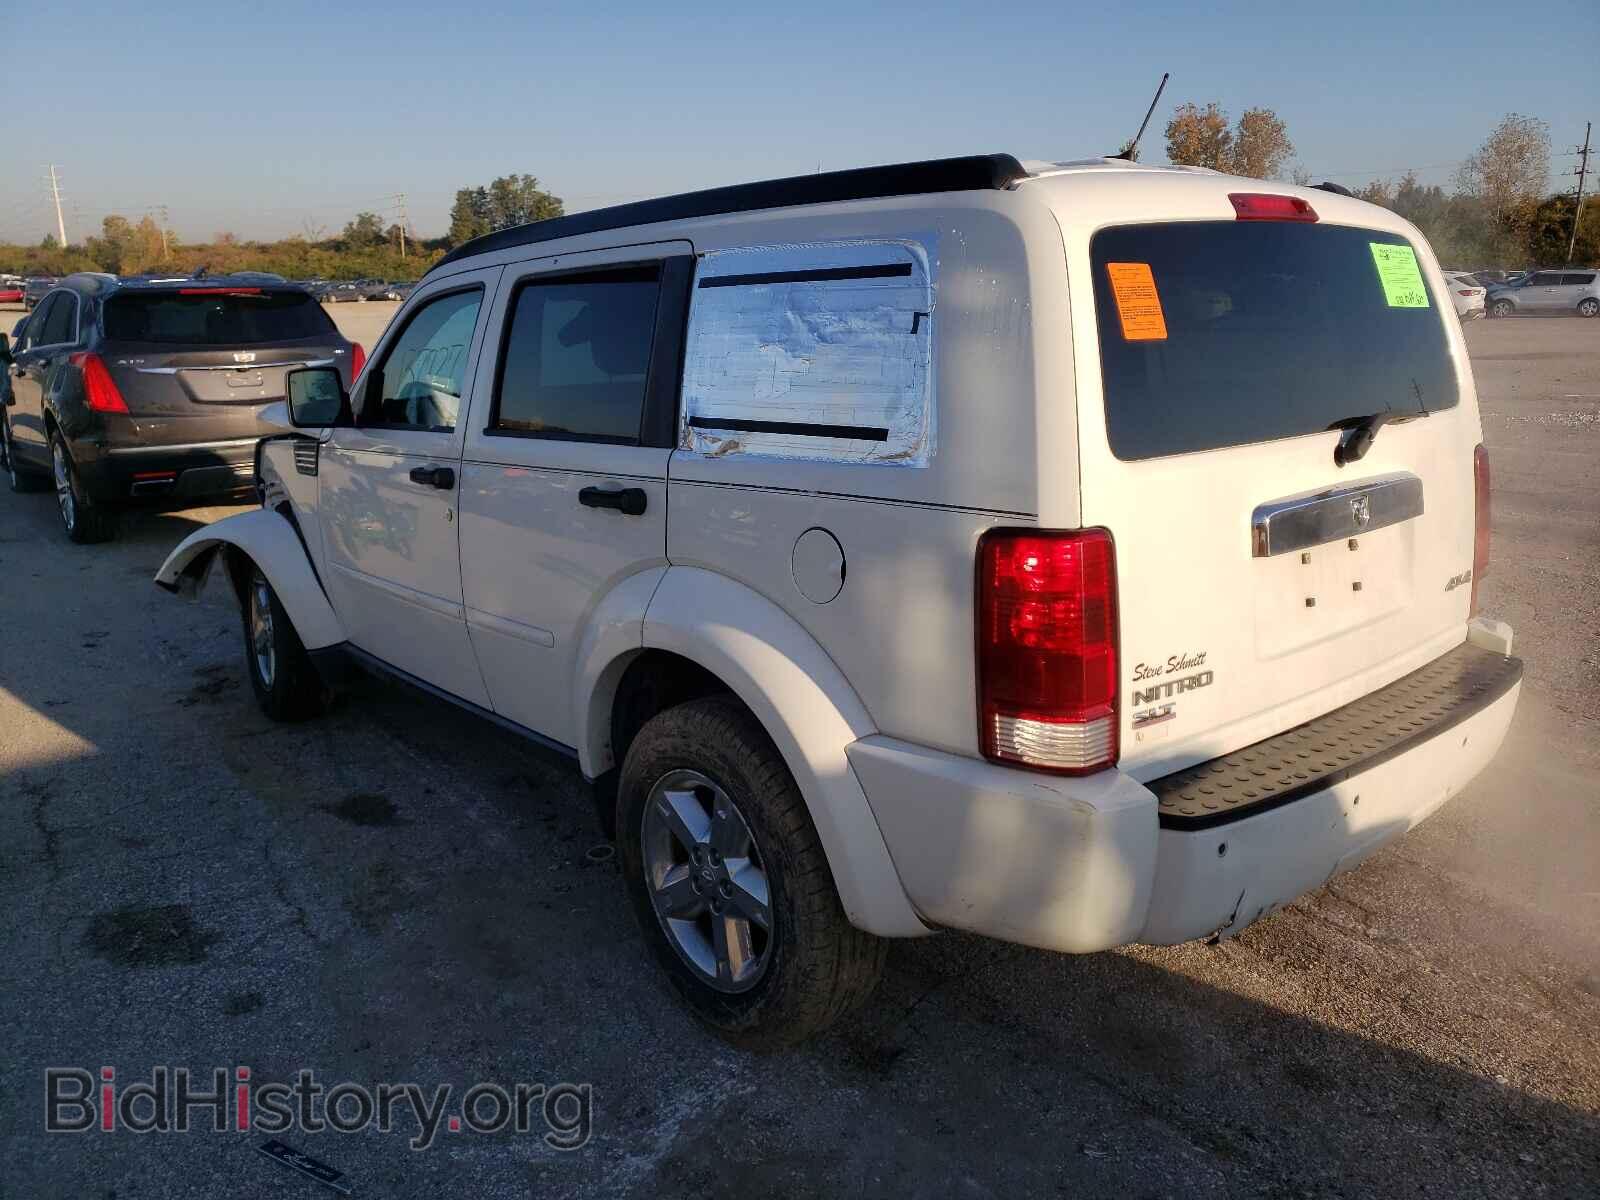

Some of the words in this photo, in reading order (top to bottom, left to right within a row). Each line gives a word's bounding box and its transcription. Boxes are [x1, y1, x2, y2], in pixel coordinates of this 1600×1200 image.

[1132, 662, 1163, 682] Steve
[1165, 651, 1207, 674] Schmitt
[1131, 669, 1214, 707] NITRO
